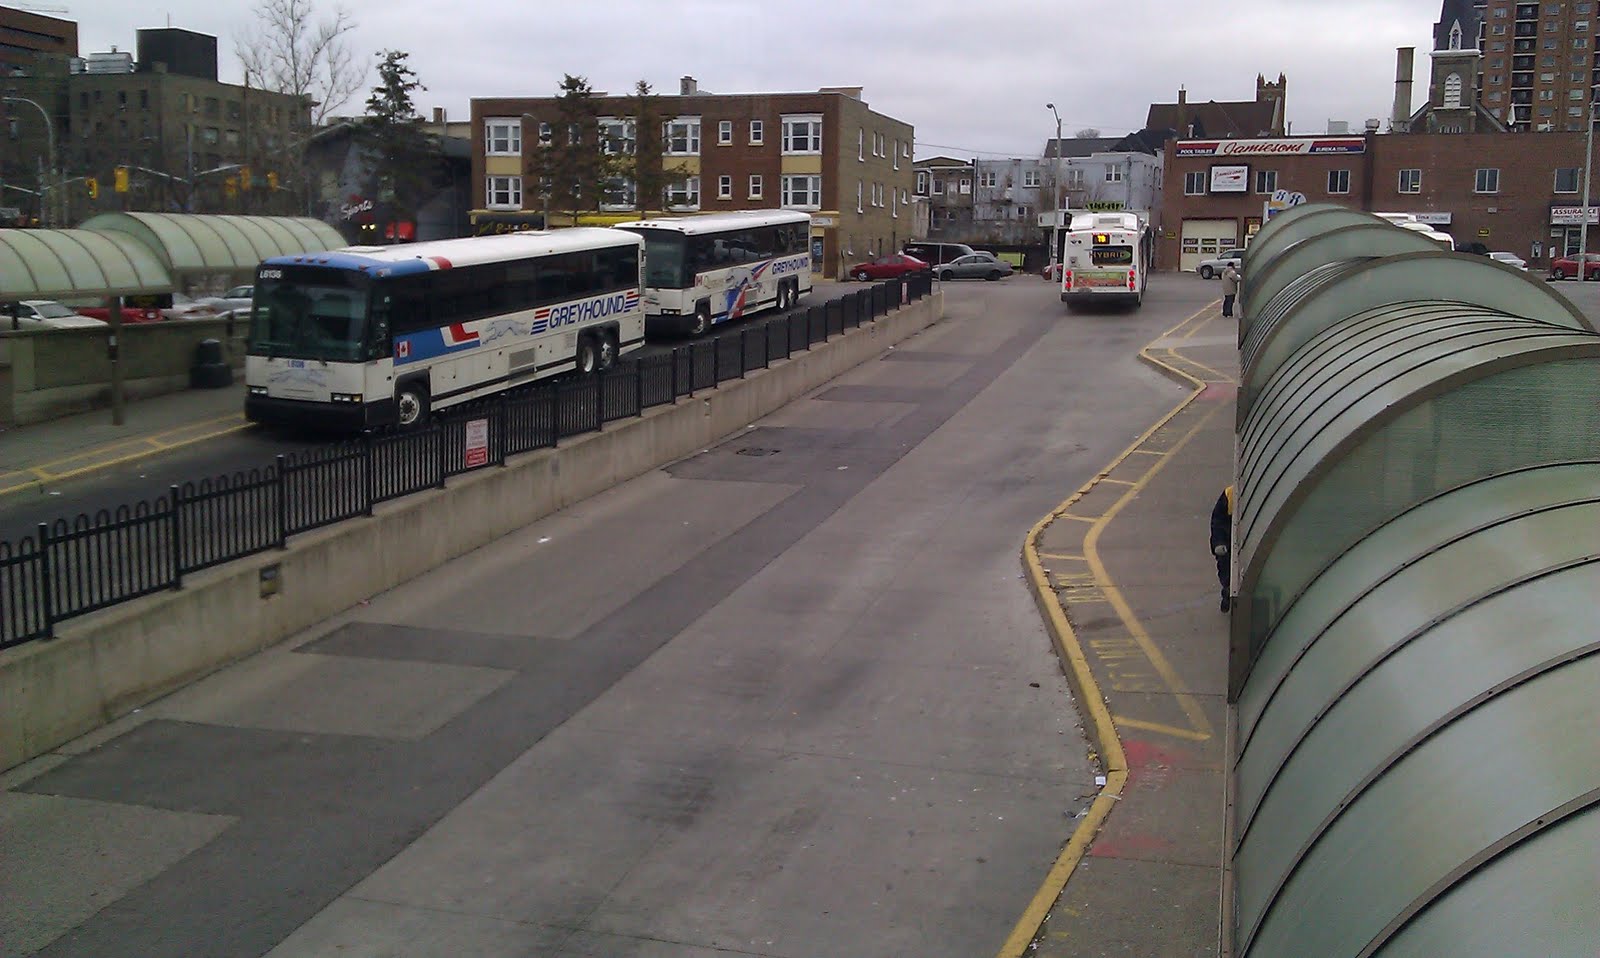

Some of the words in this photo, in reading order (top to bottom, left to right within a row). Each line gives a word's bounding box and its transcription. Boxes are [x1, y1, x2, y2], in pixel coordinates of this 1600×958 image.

[1223, 141, 1305, 155] Jamiesons
[772, 256, 809, 275] GREYHOUND
[549, 295, 625, 329] GREYHOUND
